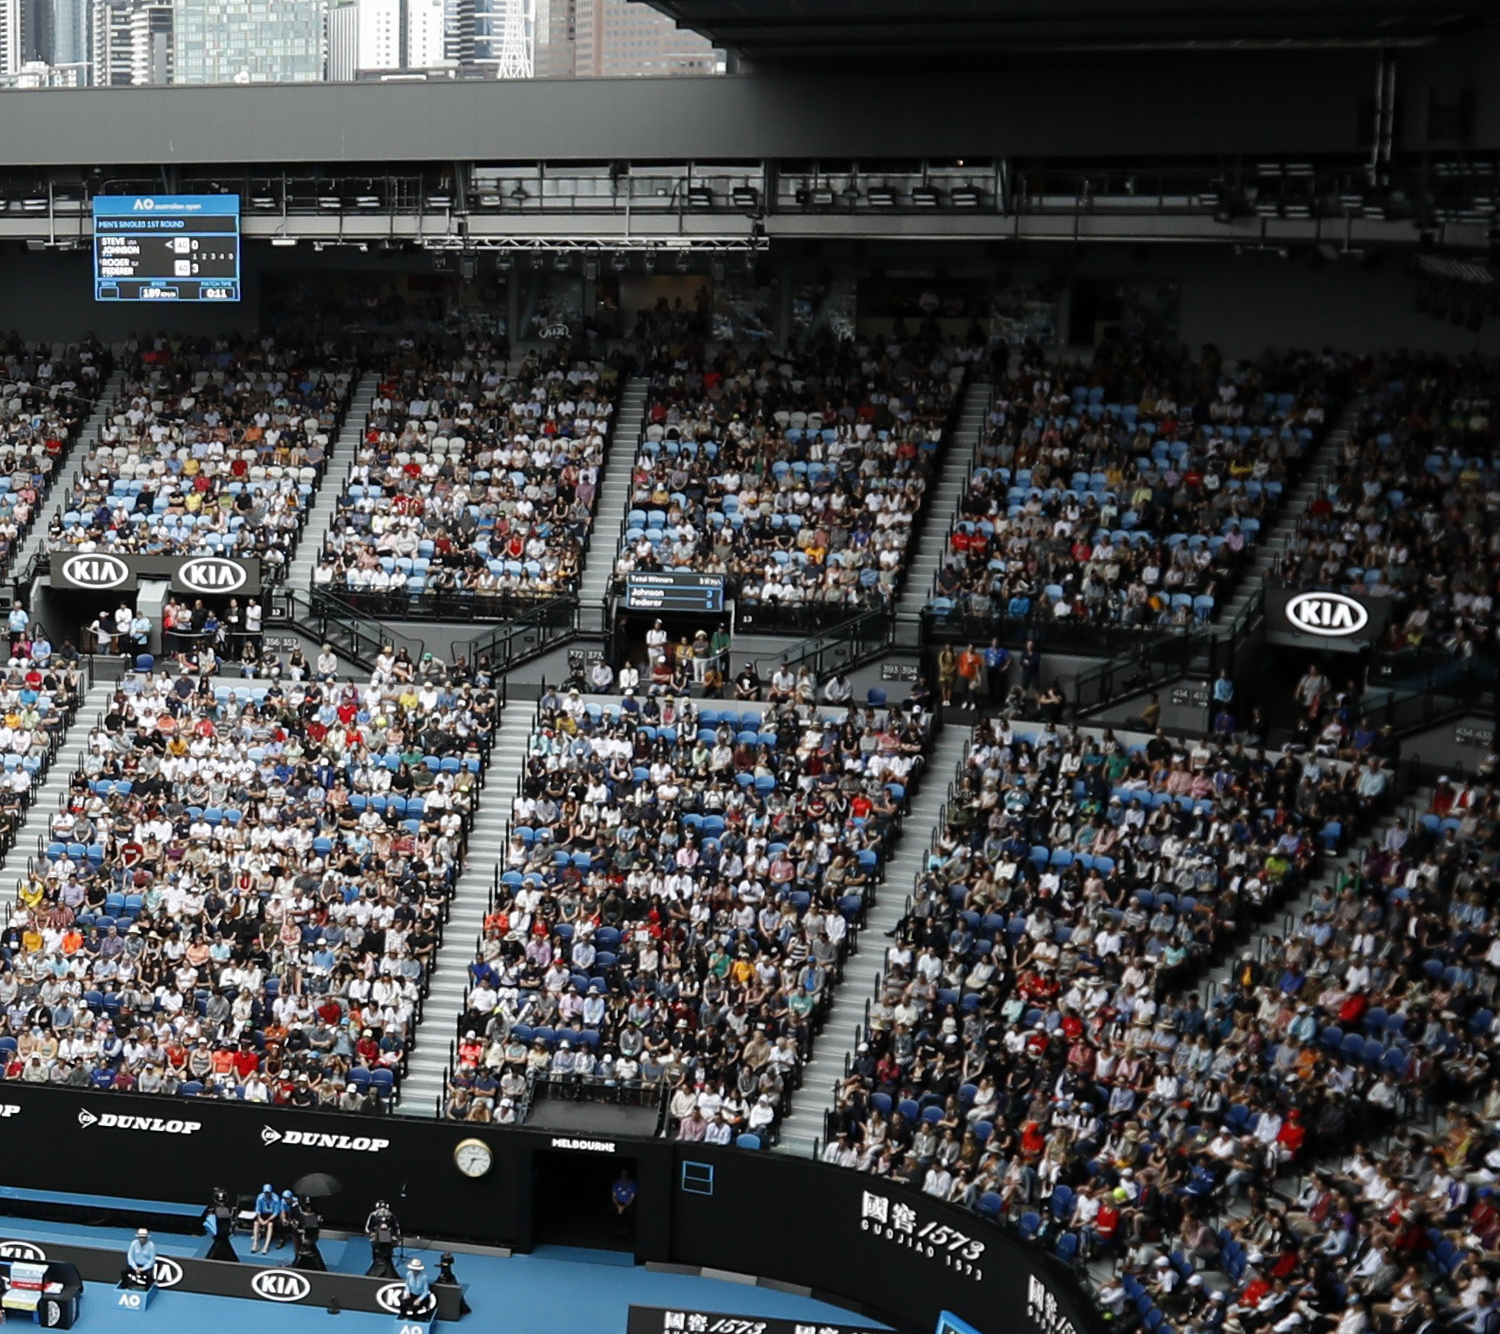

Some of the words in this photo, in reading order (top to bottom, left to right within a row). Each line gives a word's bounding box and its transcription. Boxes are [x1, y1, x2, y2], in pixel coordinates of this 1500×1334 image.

[133, 198, 154, 210] AO
[160, 220, 185, 228] ROUND
[101, 237, 126, 246] STEVE
[102, 246, 140, 255] JOHNSON
[101, 258, 130, 266] ROGER
[191, 263, 199, 274] 3
[101, 267, 134, 275] FEDERER
[74, 561, 118, 581] KIA
[190, 565, 236, 585] KIA
[631, 588, 665, 597] Johnson
[630, 597, 663, 607] Federer
[1301, 600, 1354, 627] KIA
[98, 1113, 201, 1134] DUNLOP
[282, 1130, 389, 1152] DUNLOP
[551, 1138, 616, 1153] MELBOURNE
[861, 1219, 935, 1258] GUOJIAO
[946, 1254, 983, 1282] 1573
[261, 1275, 300, 1295] KIA
[118, 1294, 141, 1307] AO
